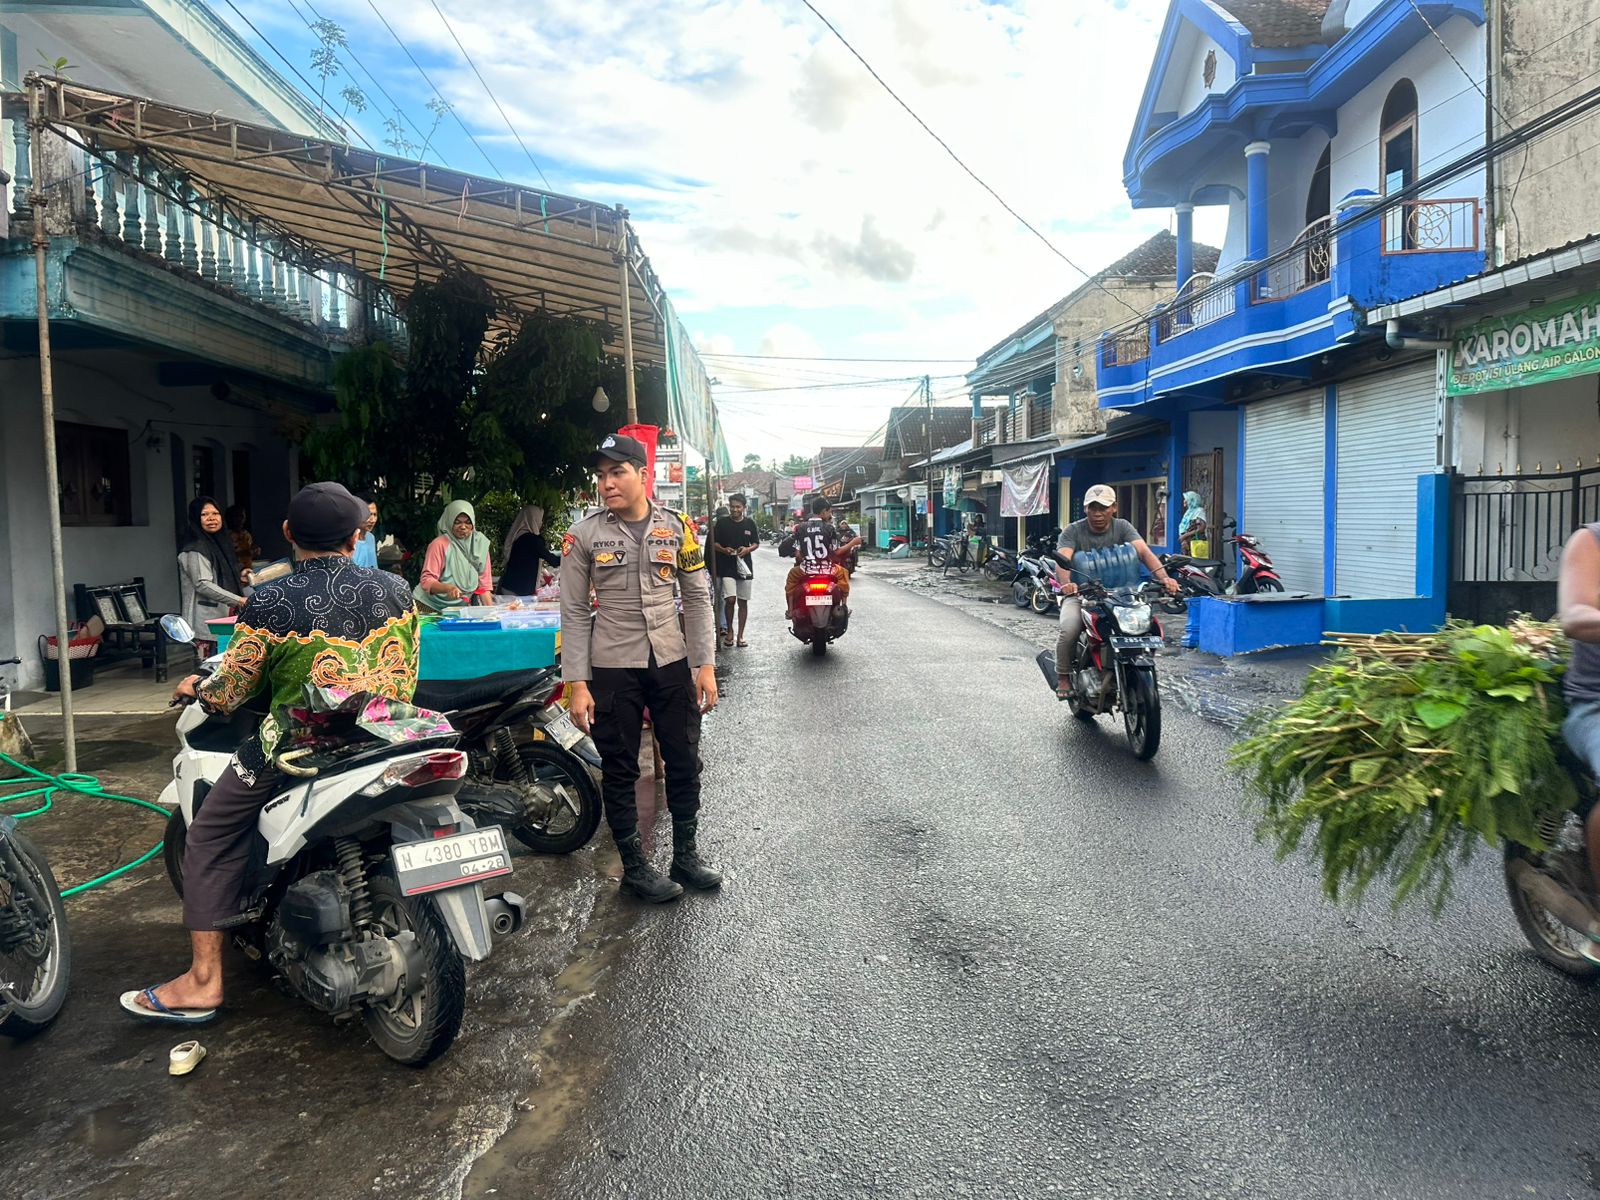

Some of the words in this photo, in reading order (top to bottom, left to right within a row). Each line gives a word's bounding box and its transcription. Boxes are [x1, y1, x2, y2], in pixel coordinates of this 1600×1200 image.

[1454, 304, 1600, 368] KAROMAH
[1452, 369, 1487, 385] DEPOT
[1488, 366, 1502, 379] ISI
[1504, 359, 1540, 376] ULANG
[1541, 357, 1562, 369] AIR
[804, 535, 828, 559] 15
[402, 853, 413, 869] N
[424, 842, 462, 863] 4380
[469, 834, 500, 855] YBM
